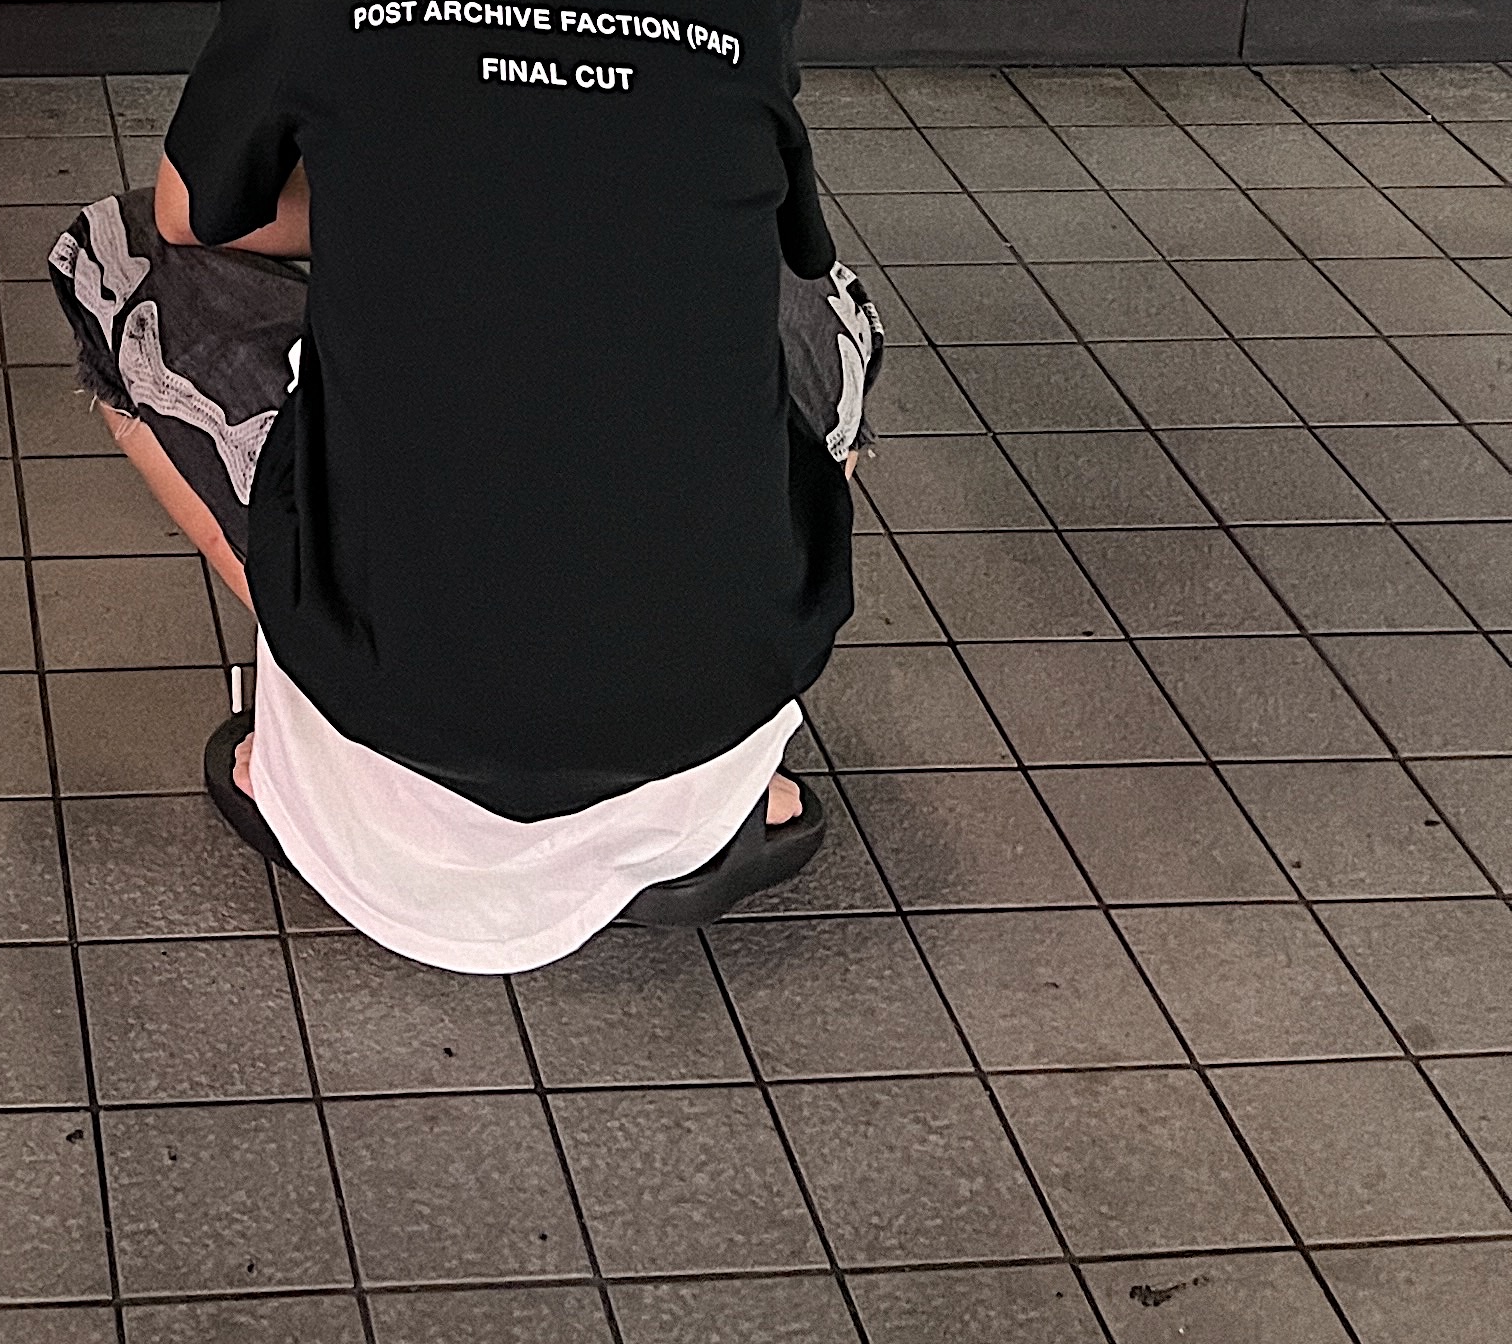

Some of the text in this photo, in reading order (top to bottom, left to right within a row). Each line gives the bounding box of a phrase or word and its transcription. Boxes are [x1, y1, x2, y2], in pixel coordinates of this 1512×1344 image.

[353, 0, 741, 65] POST ARCHIVE FACTION (PAF)
[481, 57, 635, 91] FINAL CUT
